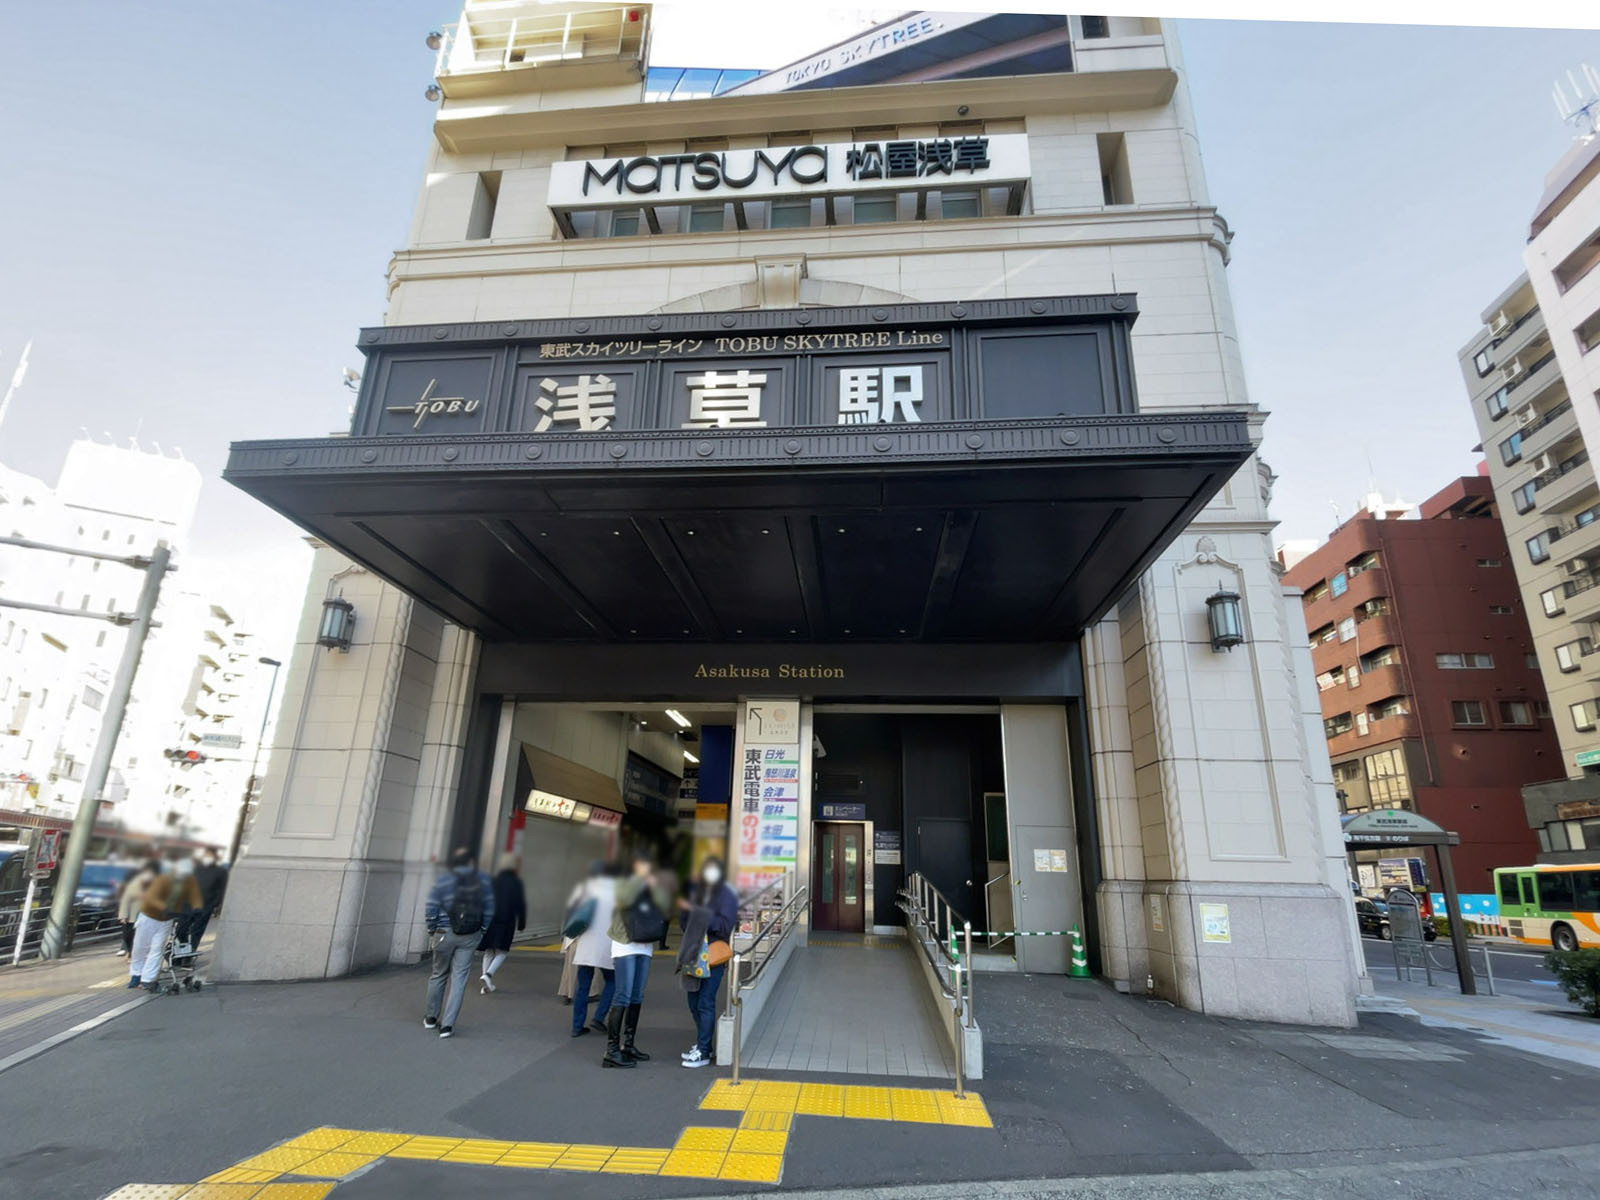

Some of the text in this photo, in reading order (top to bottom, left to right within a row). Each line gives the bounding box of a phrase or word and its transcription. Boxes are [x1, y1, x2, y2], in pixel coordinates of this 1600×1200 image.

[786, 58, 832, 84] TOKYO
[846, 136, 991, 181] 松屋浅草
[539, 329, 944, 359] 東武スカイツリーライン TOBU SKYTREE Line
[694, 664, 846, 679] Asakusa Station
[764, 749, 785, 760] 日光
